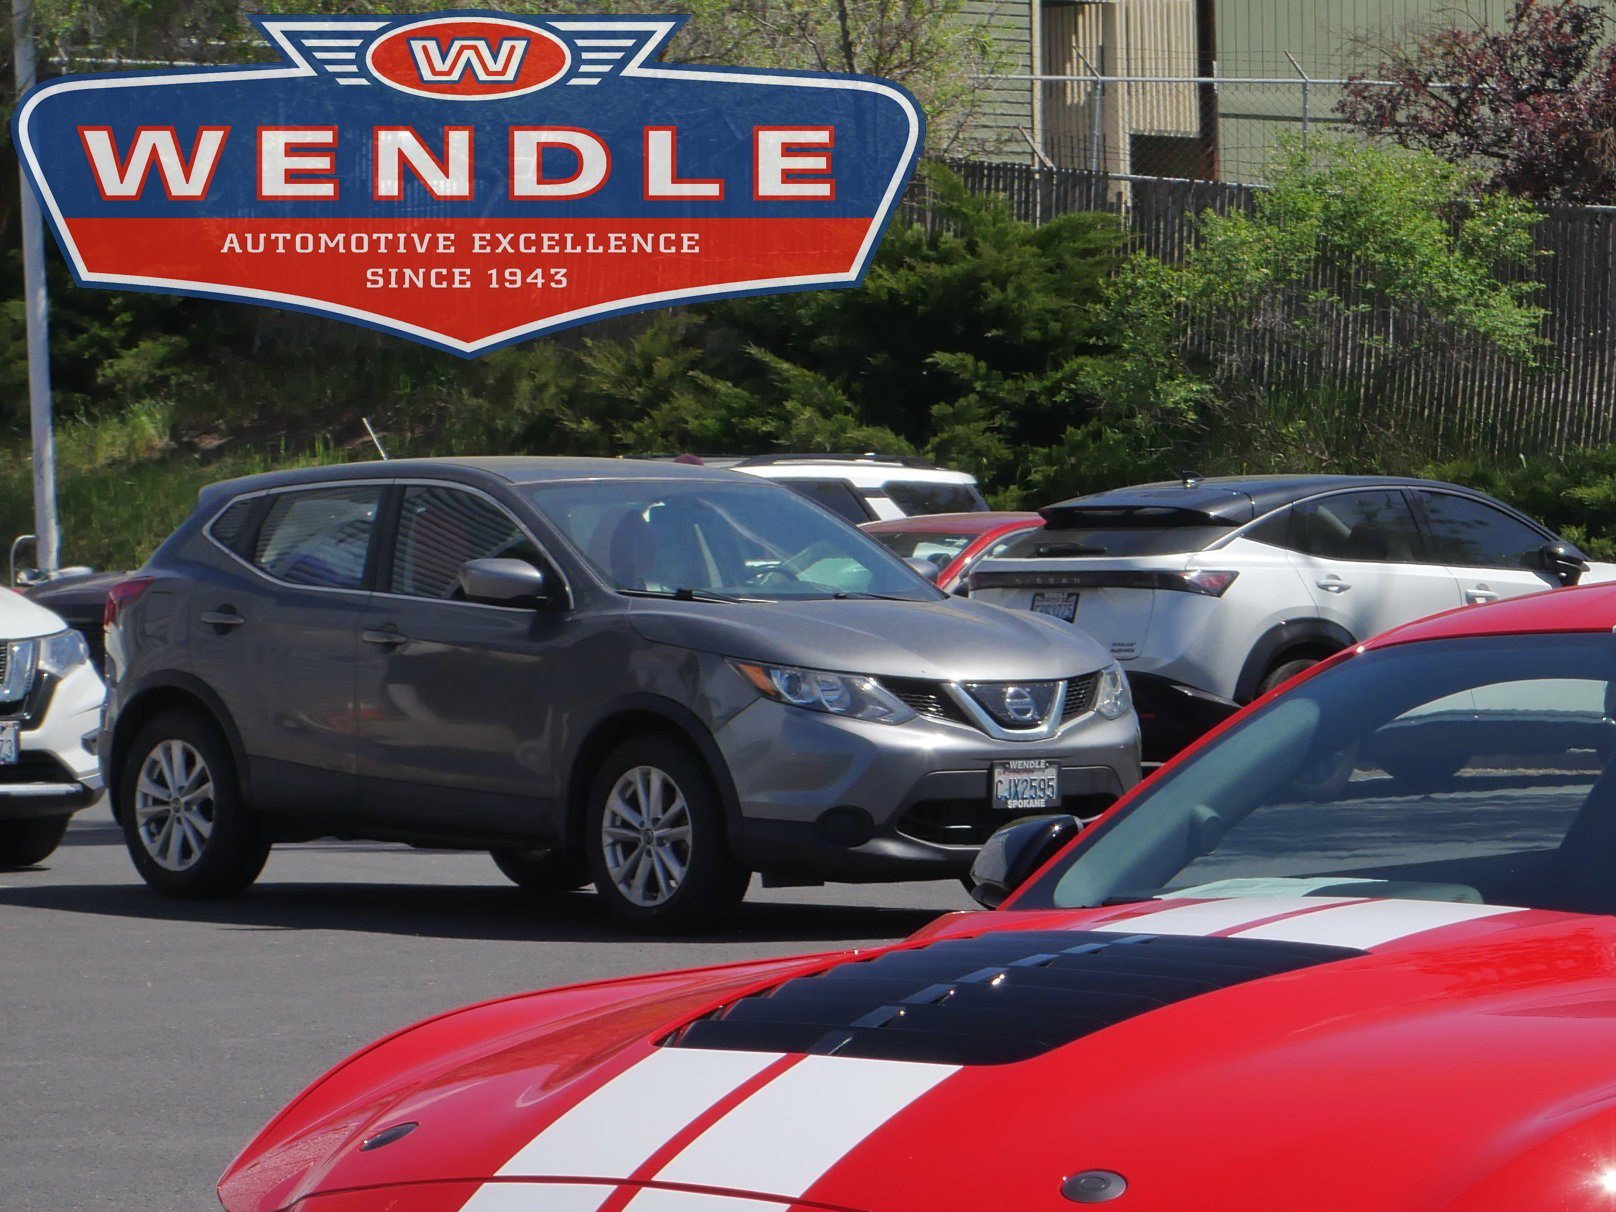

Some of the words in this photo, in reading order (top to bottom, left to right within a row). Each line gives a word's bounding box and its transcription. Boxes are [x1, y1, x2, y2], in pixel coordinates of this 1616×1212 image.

[1009, 760, 1046, 769] WENDLE
[996, 776, 1055, 800] CJX2595
[1007, 799, 1046, 809] SPOKANE
